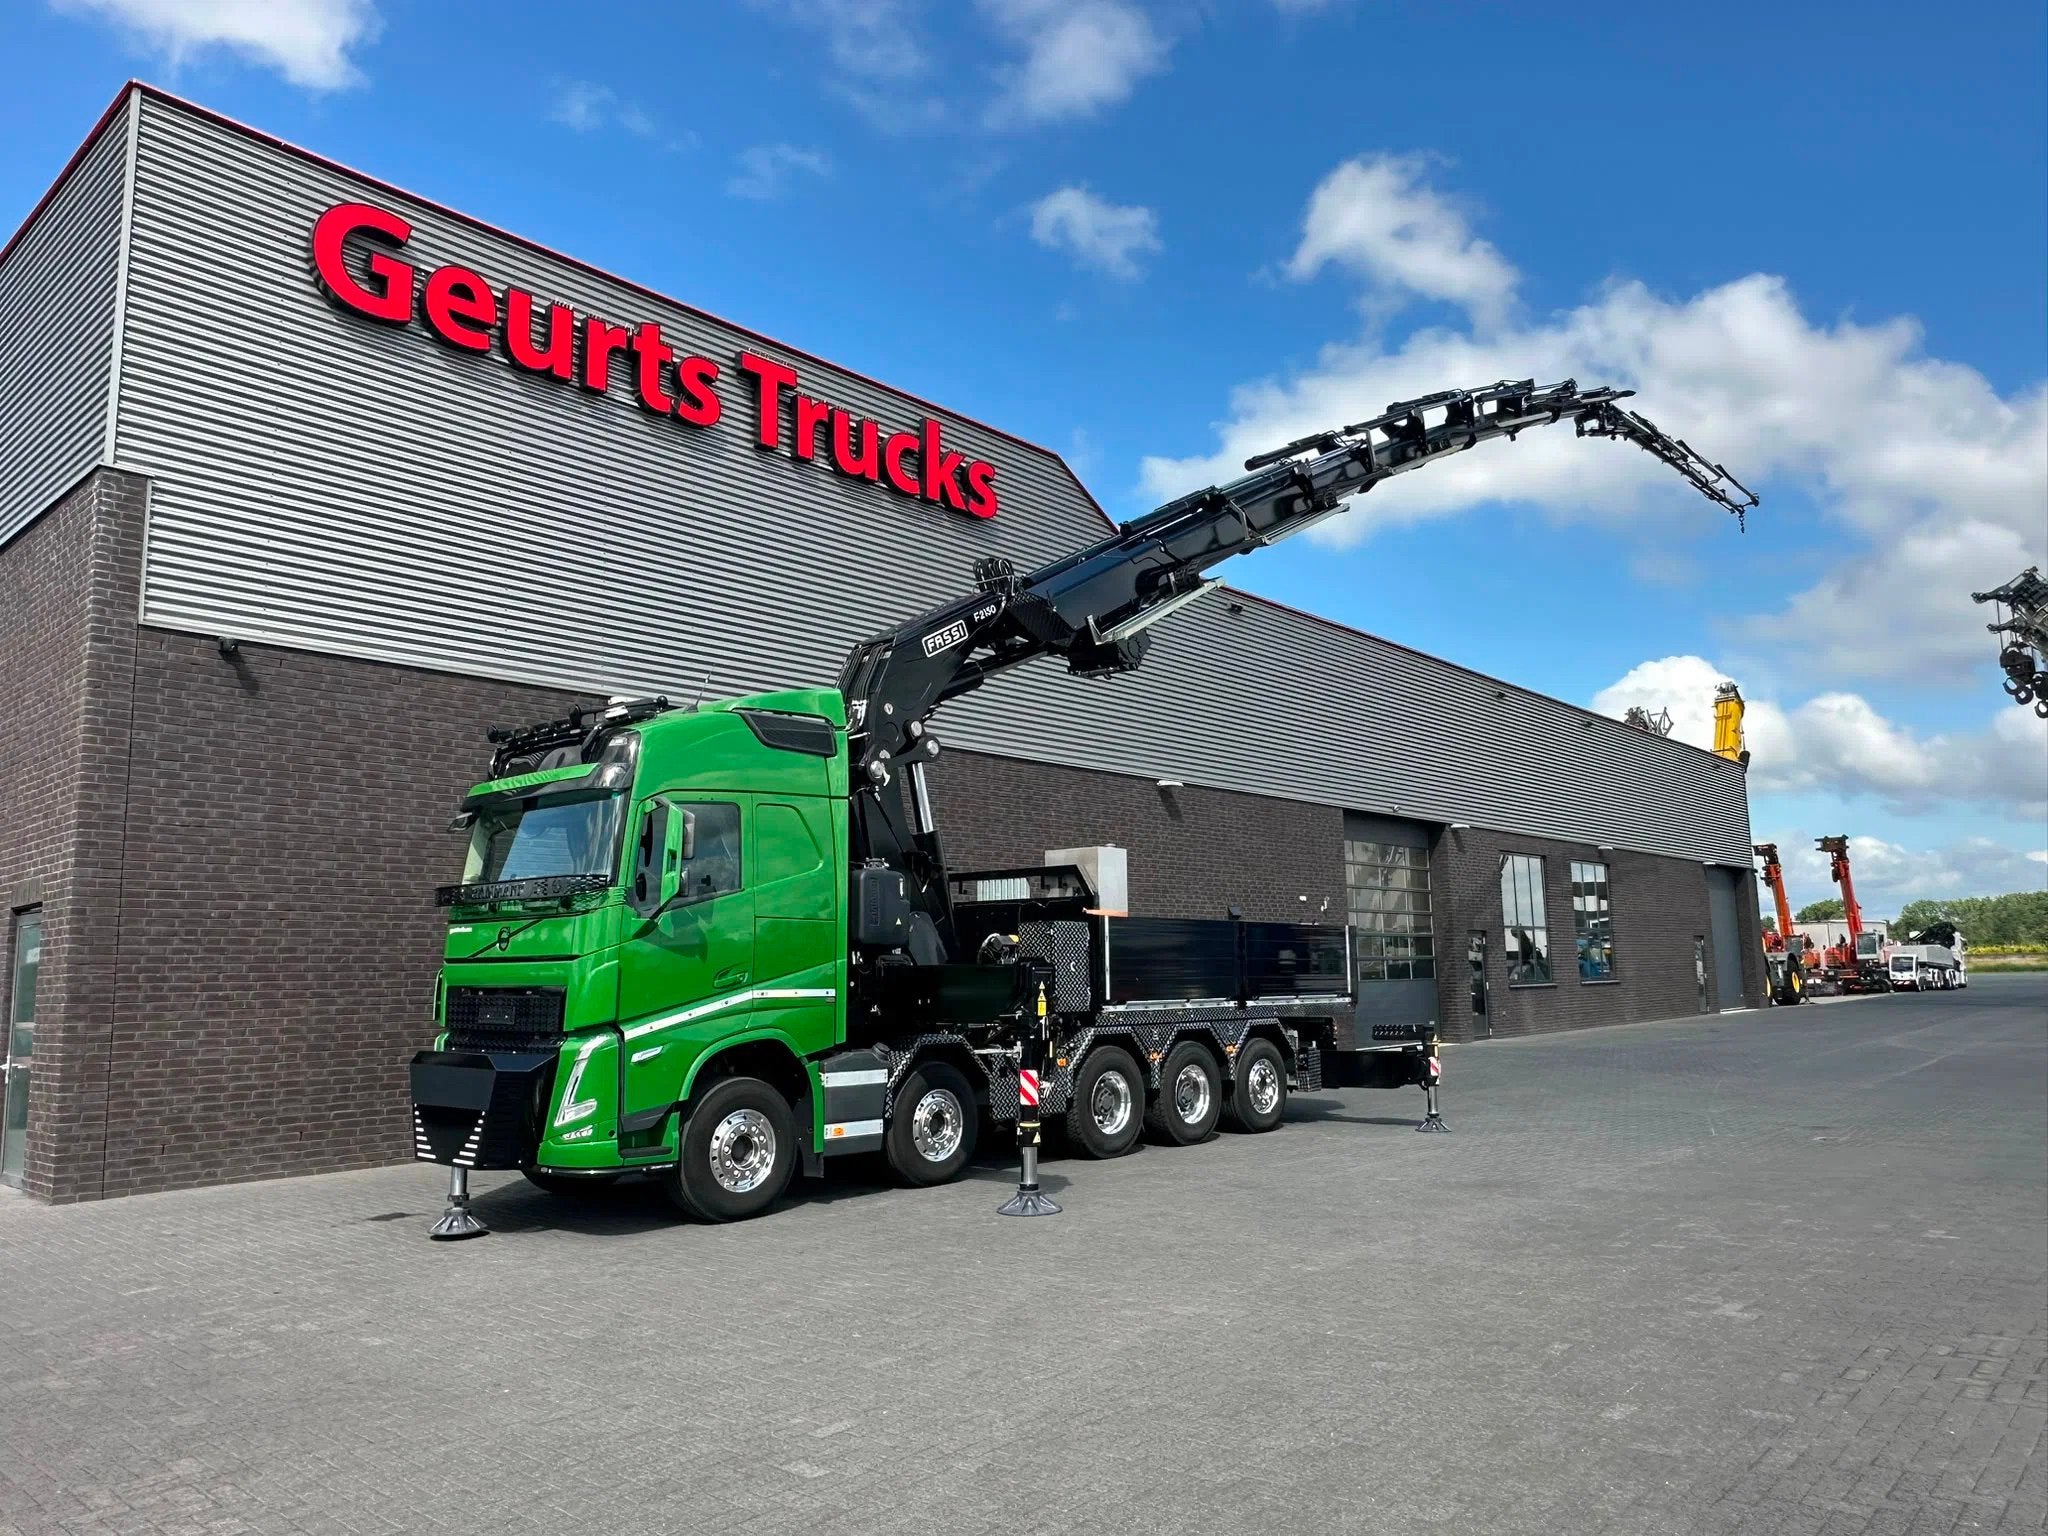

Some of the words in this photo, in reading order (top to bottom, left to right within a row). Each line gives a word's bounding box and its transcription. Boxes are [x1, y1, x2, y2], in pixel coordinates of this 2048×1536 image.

[311, 203, 722, 427] Geurts
[738, 351, 999, 520] Trucks
[926, 623, 965, 653] FASSI
